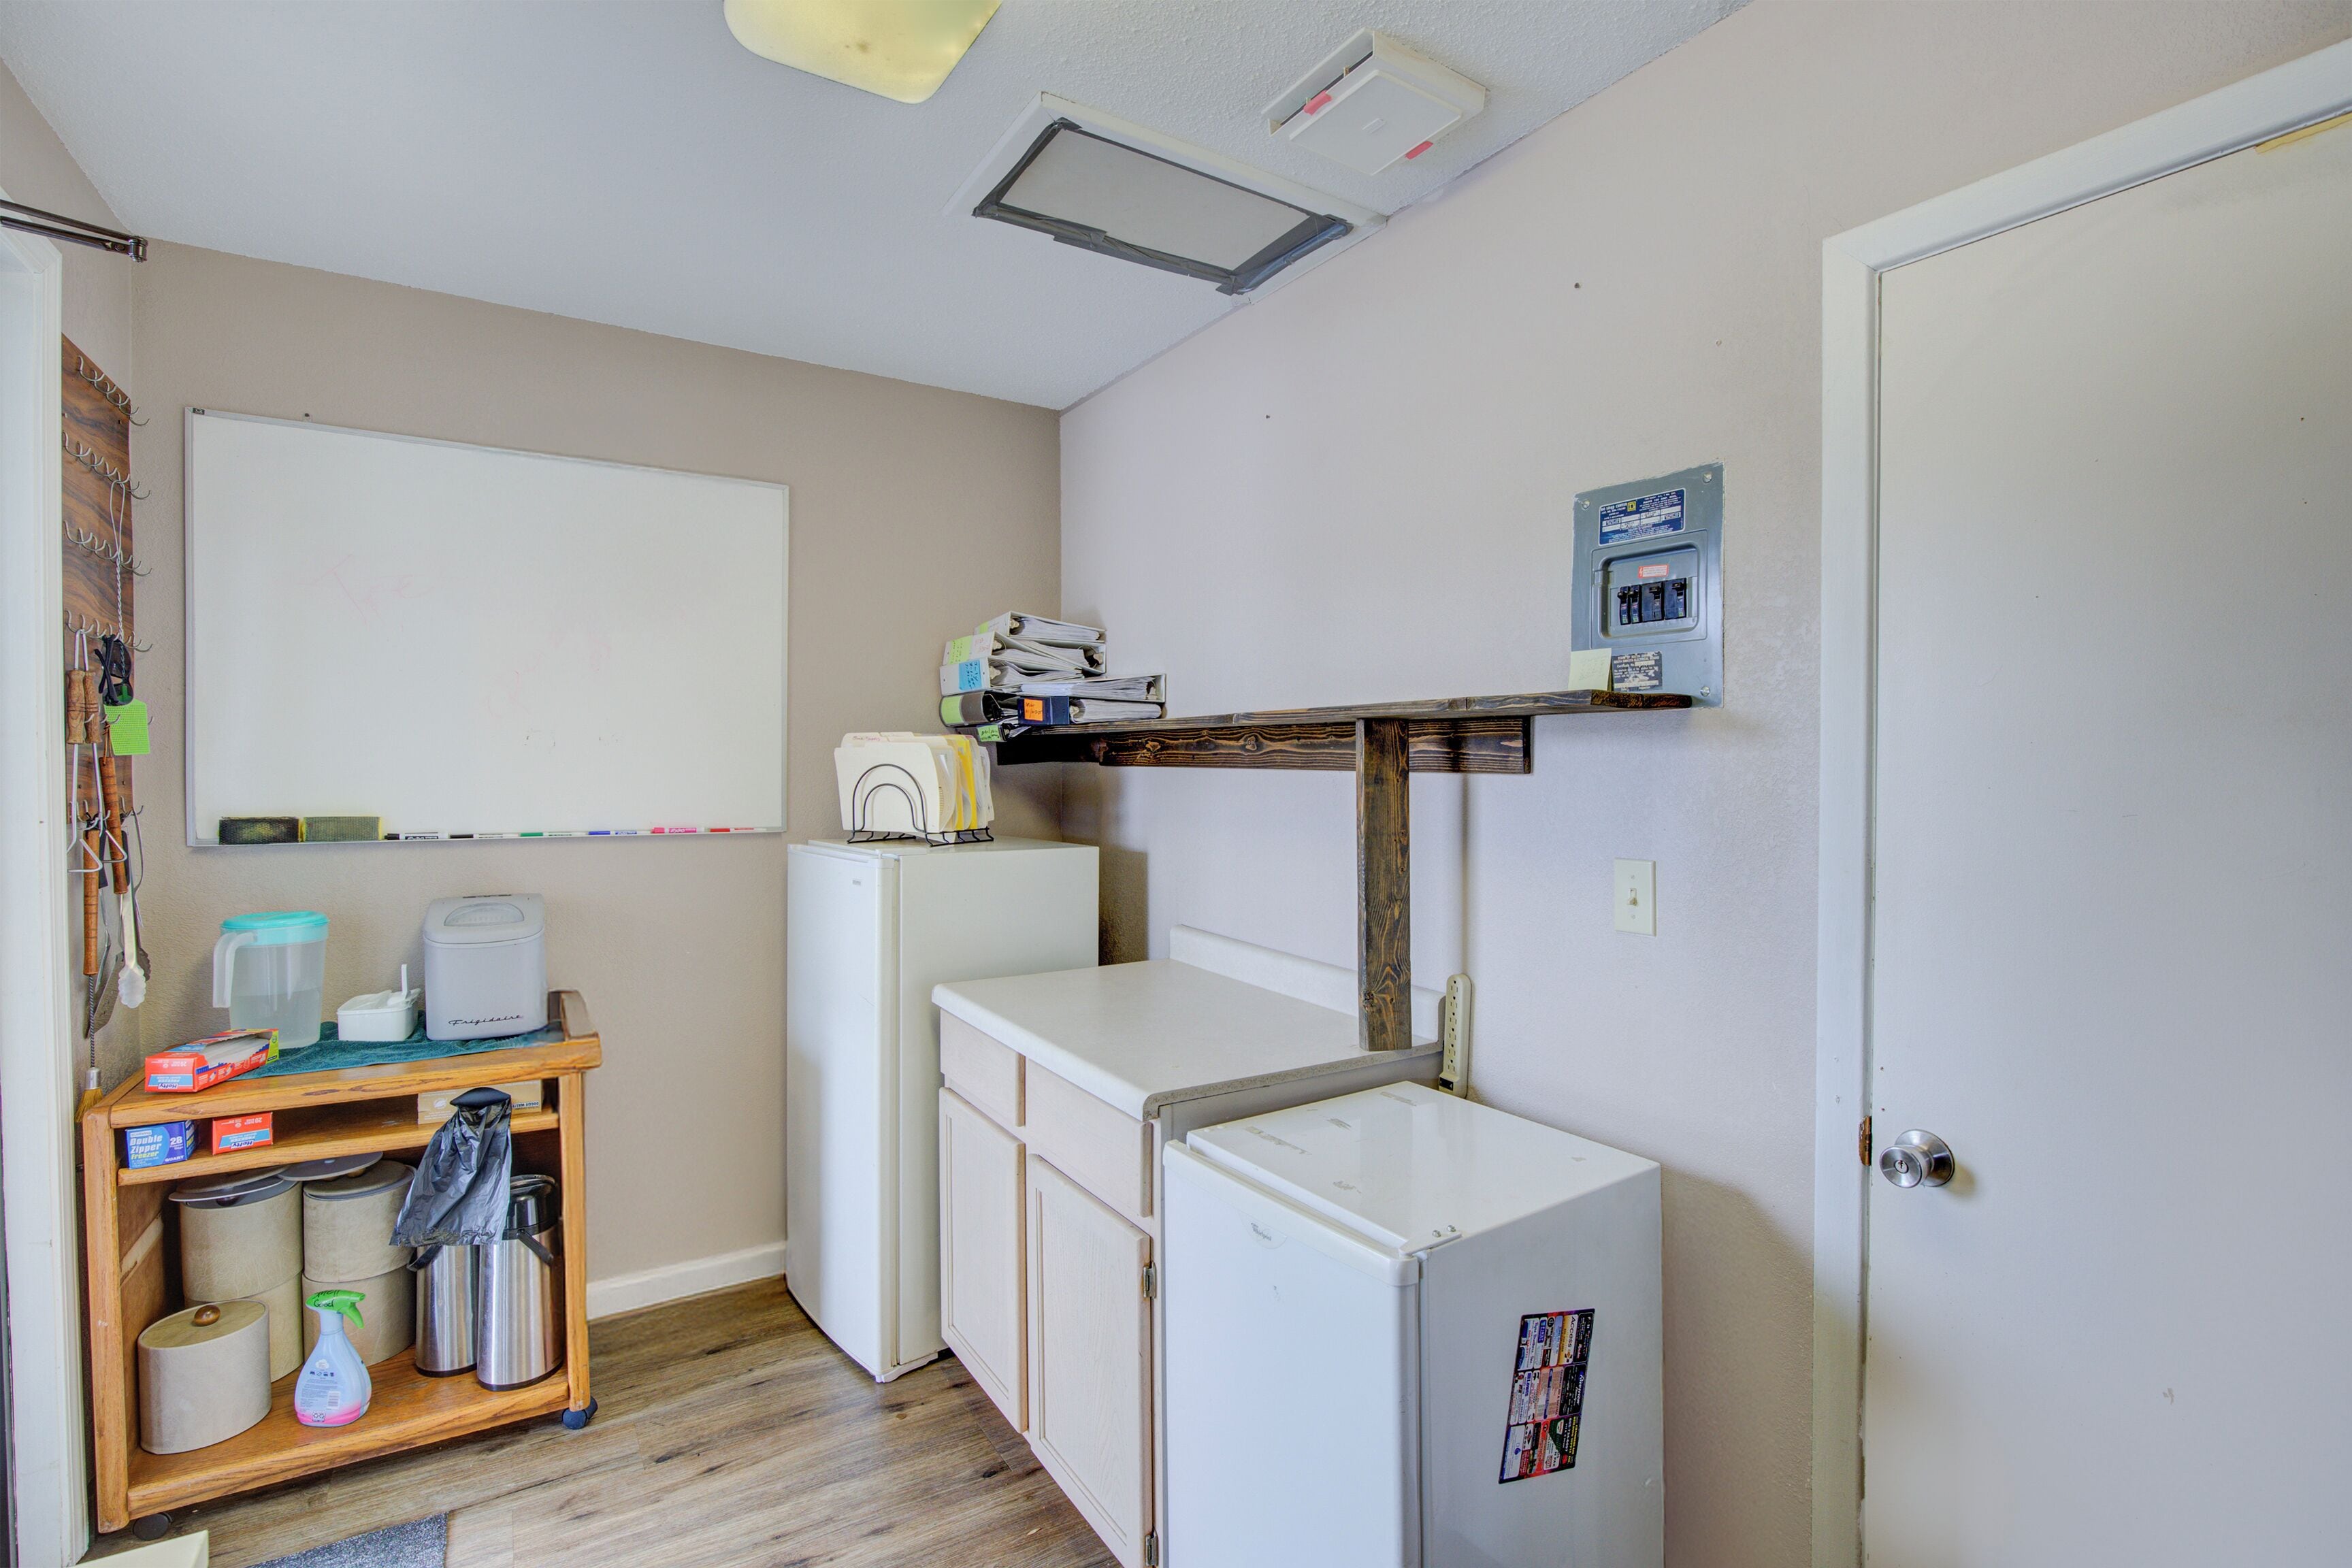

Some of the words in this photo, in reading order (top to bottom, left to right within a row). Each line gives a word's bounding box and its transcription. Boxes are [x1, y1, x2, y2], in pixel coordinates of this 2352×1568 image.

[448, 1014, 523, 1026] Frigidaire
[130, 1135, 163, 1146] Double
[169, 1136, 182, 1145] 28
[130, 1143, 161, 1154] Zipper
[1252, 1226, 1272, 1241] Whirlpool
[1567, 1316, 1576, 1348] Access
